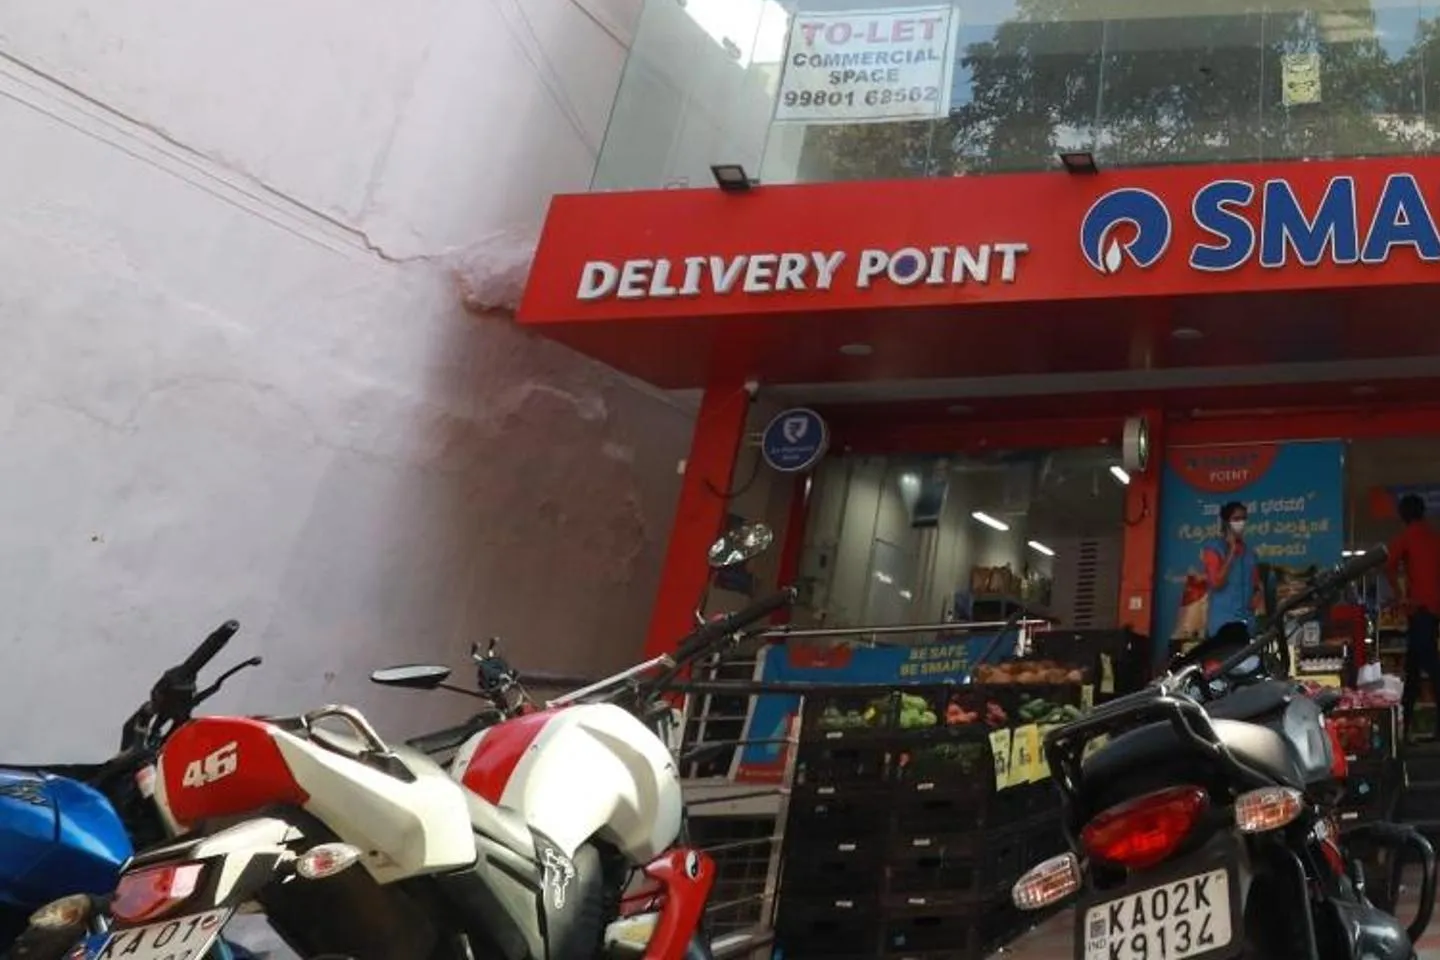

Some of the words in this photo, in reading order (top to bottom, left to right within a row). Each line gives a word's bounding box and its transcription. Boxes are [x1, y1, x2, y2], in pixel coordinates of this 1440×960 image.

[801, 17, 943, 47] TO-LET
[792, 48, 941, 69] COMMERCIAL
[828, 68, 900, 86] SPACE
[576, 250, 846, 300] DELIVERY
[856, 243, 1030, 288] POINT
[182, 740, 238, 788] 46
